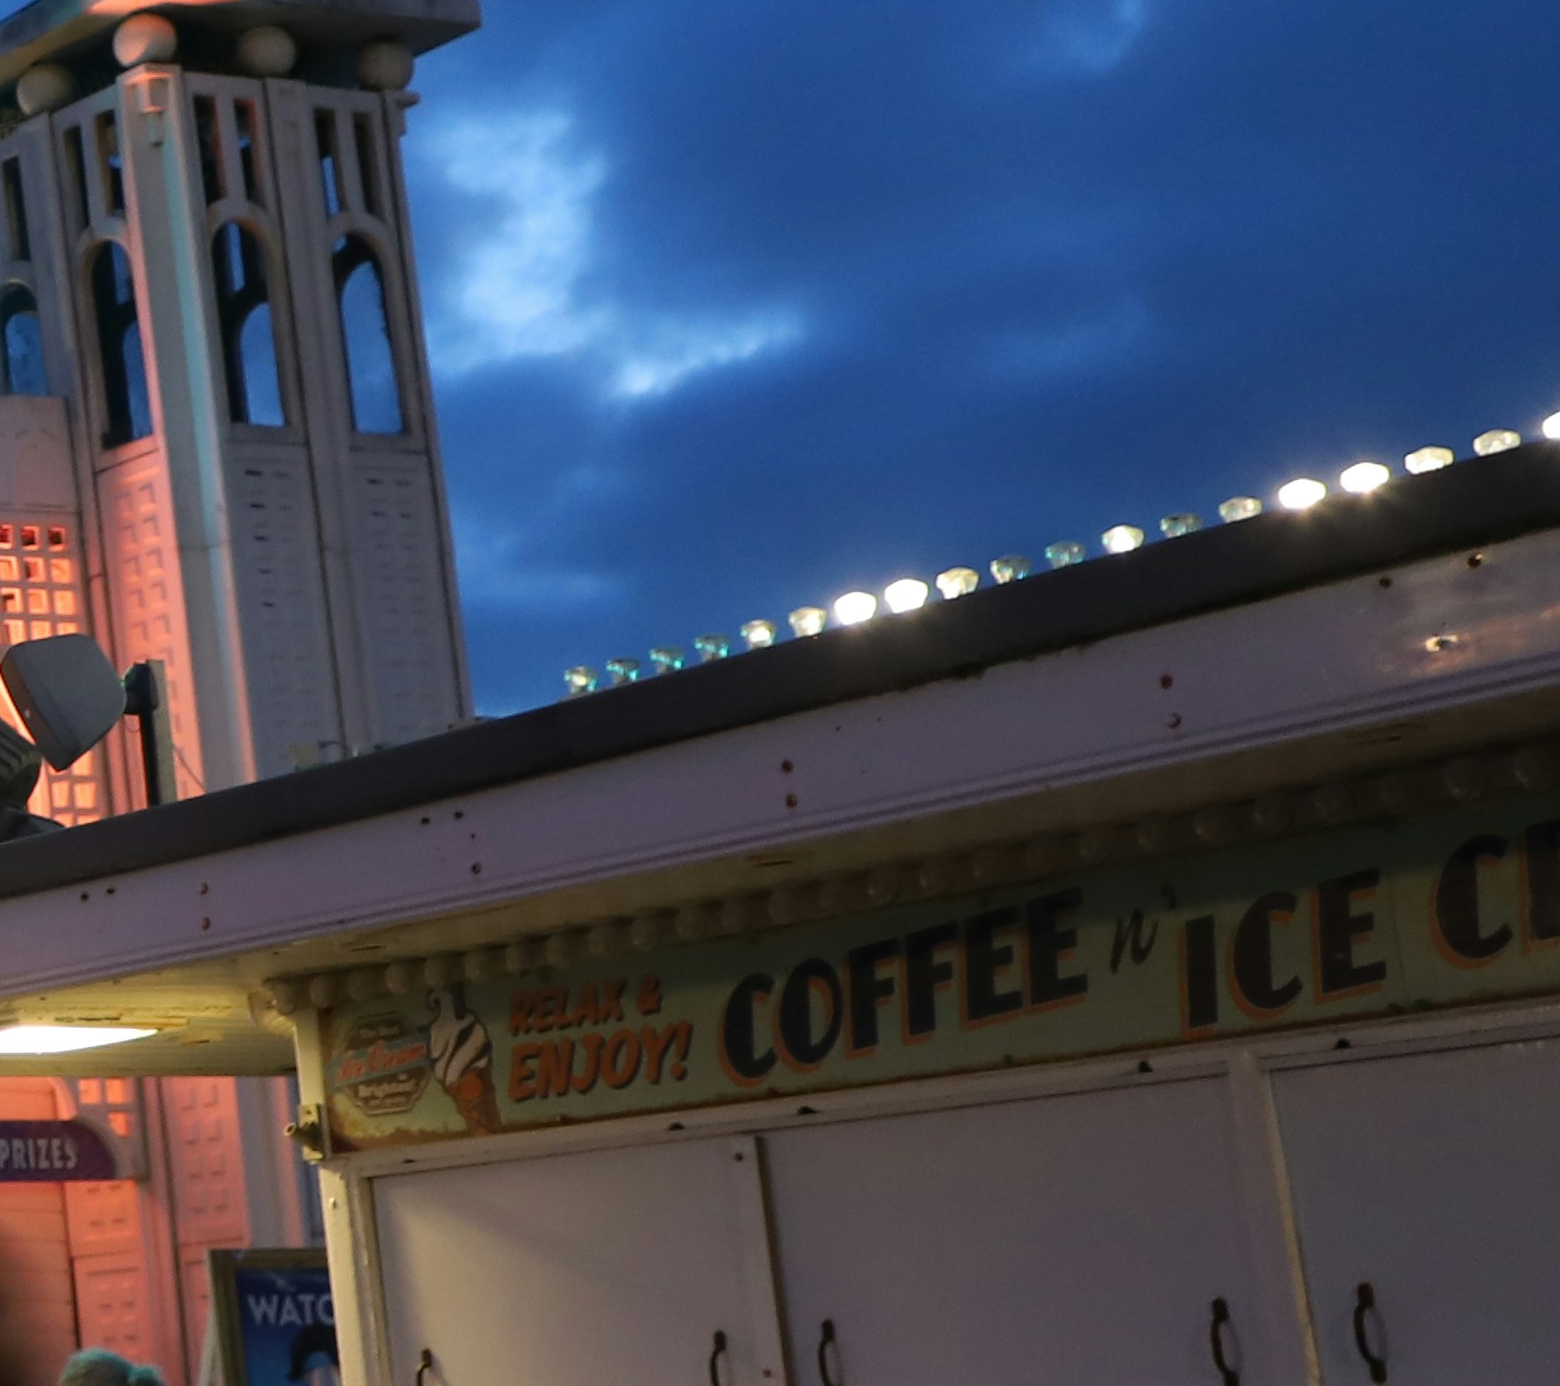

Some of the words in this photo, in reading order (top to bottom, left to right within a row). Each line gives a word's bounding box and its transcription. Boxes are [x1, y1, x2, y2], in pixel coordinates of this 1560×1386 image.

[509, 978, 628, 1036] RELAX
[636, 975, 662, 1014] &
[718, 887, 1089, 1088] COFFEE
[1178, 868, 1387, 1040] ICE
[508, 1018, 693, 1102] ENJOY!
[246, 1292, 335, 1327] WATC
